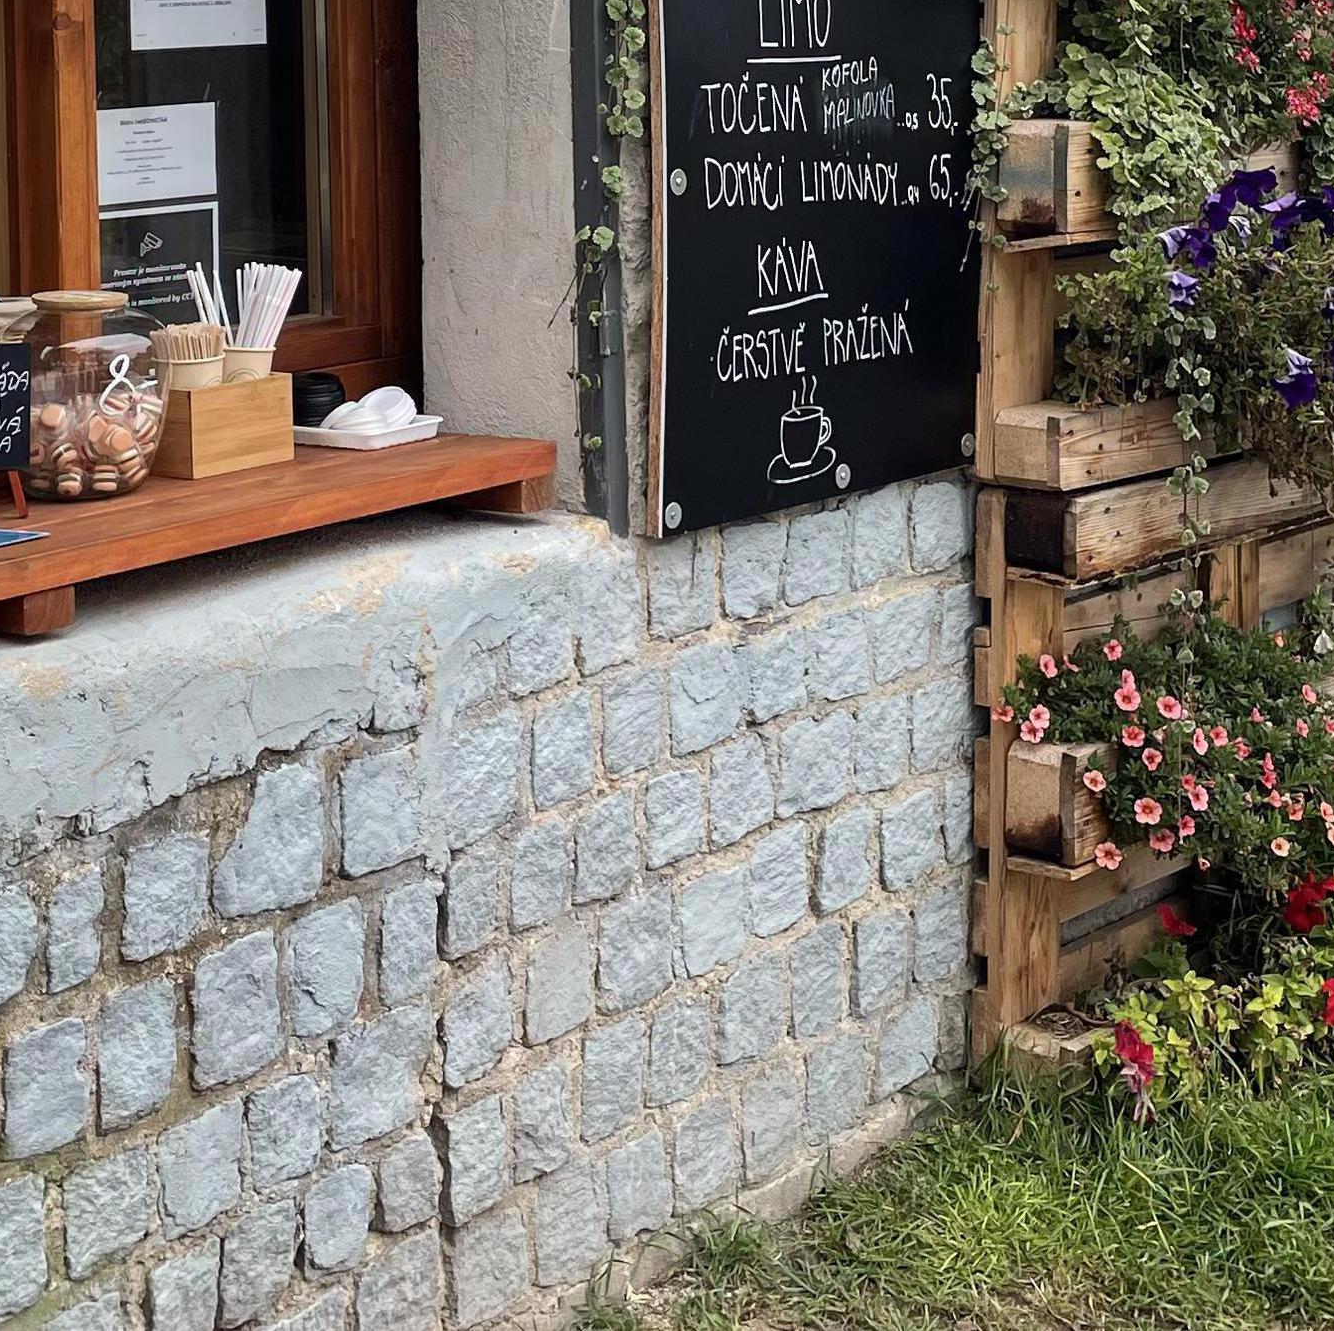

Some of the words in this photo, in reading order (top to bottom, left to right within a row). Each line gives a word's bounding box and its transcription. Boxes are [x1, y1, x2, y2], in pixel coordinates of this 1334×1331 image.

[700, 71, 808, 135] TOČENÁ
[822, 56, 879, 92] KOFOLA
[704, 152, 786, 211] DOMÁCÍ
[800, 152, 898, 207] LIMONÁDY
[757, 237, 825, 298] KÁVA
[823, 299, 914, 367] PRAŽENÁ
